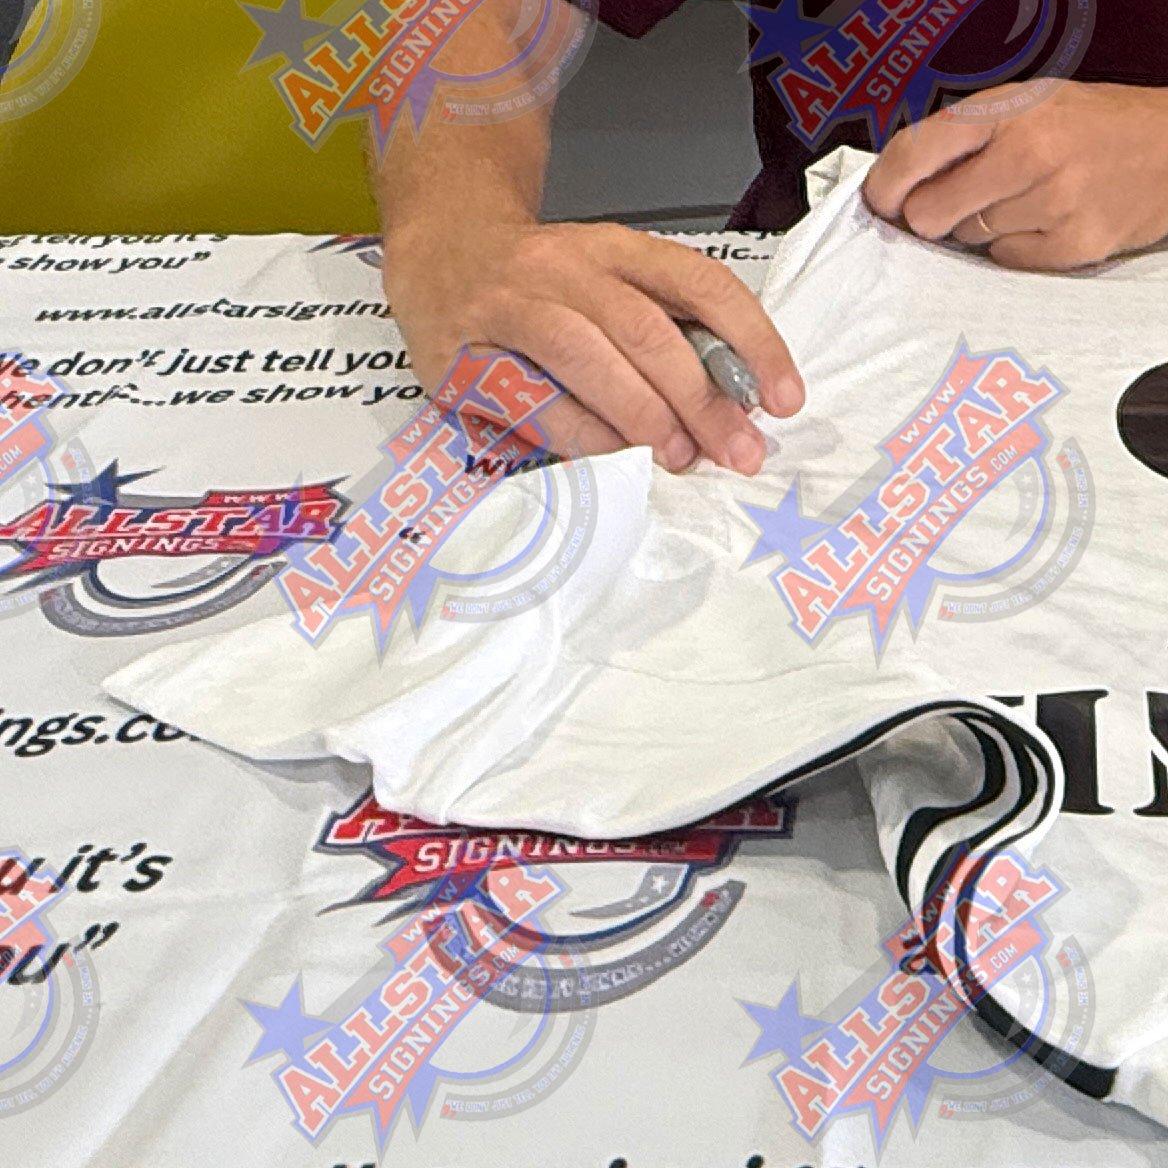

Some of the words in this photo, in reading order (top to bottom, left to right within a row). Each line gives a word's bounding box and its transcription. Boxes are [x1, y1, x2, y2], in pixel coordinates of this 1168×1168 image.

[7, 253, 112, 272] show
[158, 348, 251, 377] just
[260, 348, 334, 374] tell
[240, 383, 360, 405] show
[362, 385, 432, 407] yo
[0, 497, 340, 540] ALLSTAR
[49, 842, 174, 893] it's
